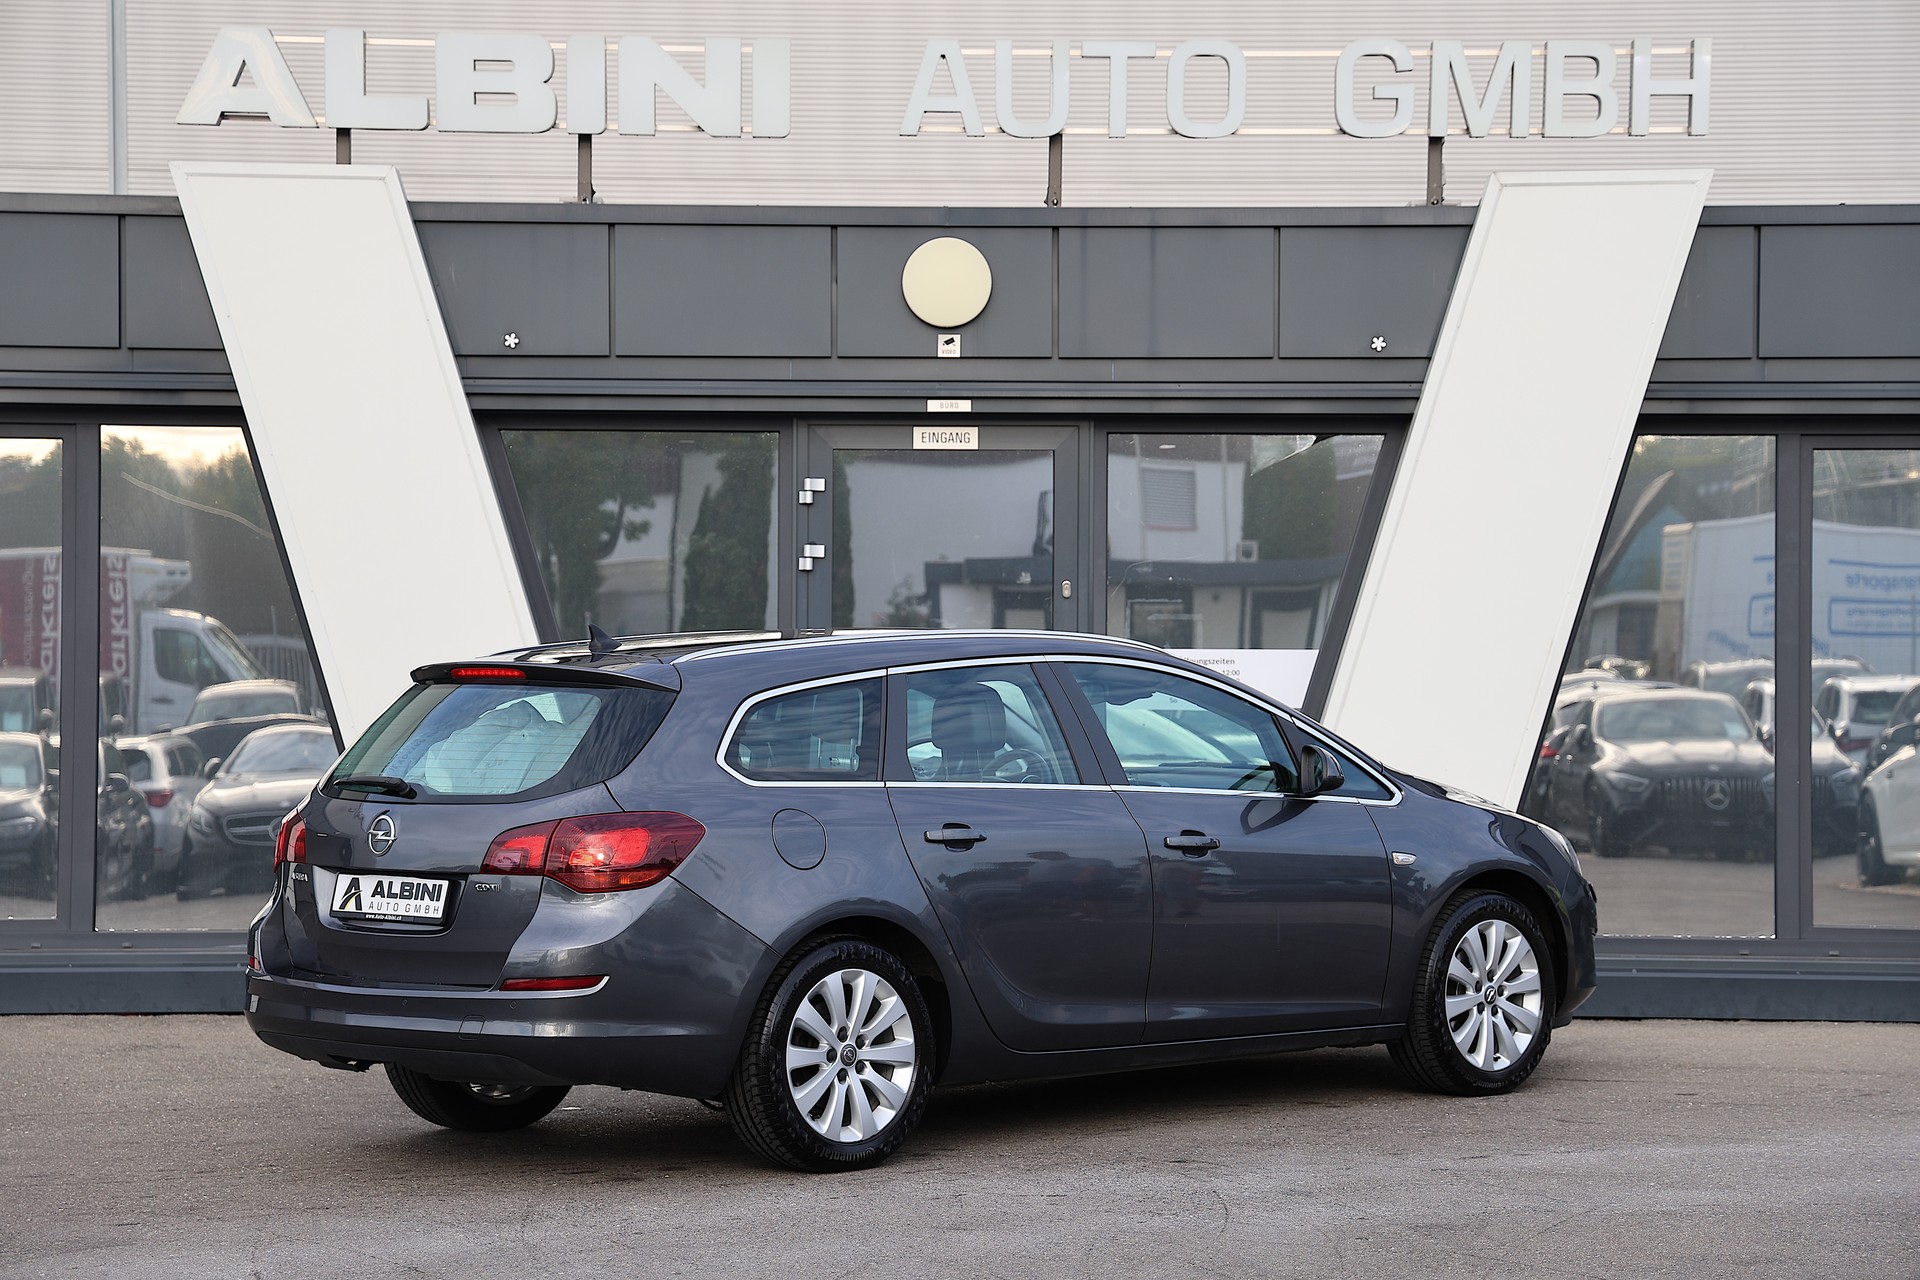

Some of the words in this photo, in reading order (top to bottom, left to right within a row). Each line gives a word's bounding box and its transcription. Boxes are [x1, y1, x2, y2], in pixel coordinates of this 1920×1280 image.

[176, 26, 791, 138] ALBINI
[899, 38, 1247, 139] AUTO
[1334, 37, 1713, 139] GMBH
[939, 401, 959, 409] BÜRO
[921, 431, 971, 444] EINGANG
[371, 880, 443, 902] ALBINI
[368, 901, 399, 912] AUTO
[405, 903, 440, 915] GMBH
